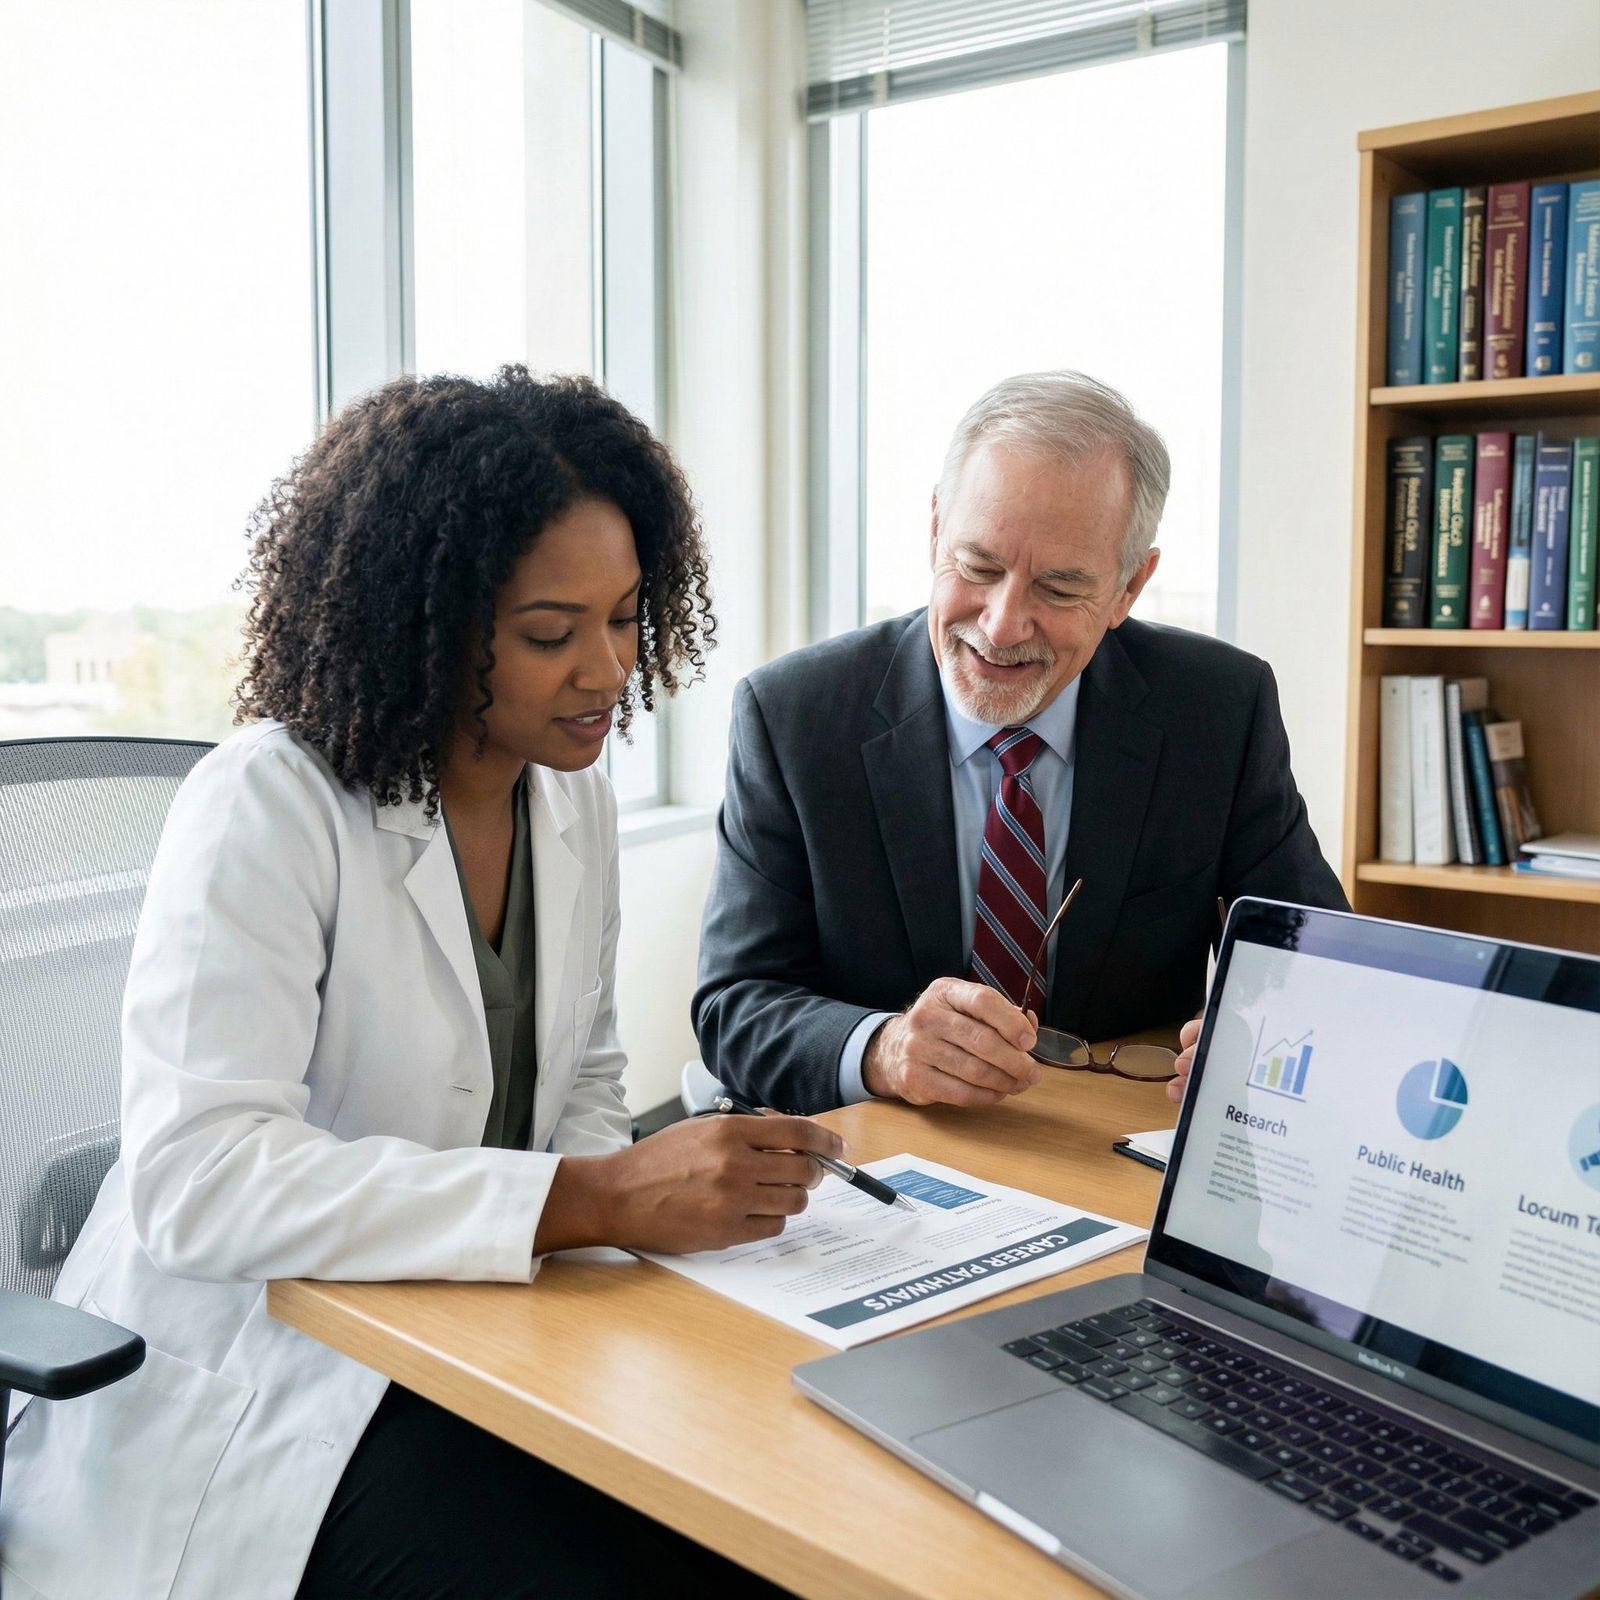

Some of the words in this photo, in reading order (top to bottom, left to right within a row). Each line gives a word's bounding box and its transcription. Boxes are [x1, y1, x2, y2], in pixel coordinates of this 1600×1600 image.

[1225, 1104, 1288, 1138] Research
[1356, 1145, 1407, 1175] Public
[1409, 1160, 1466, 1193] Health
[1518, 1194, 1580, 1230] Locum
[982, 1234, 1069, 1268] CAREER
[863, 1263, 989, 1311] PATHWAYS
